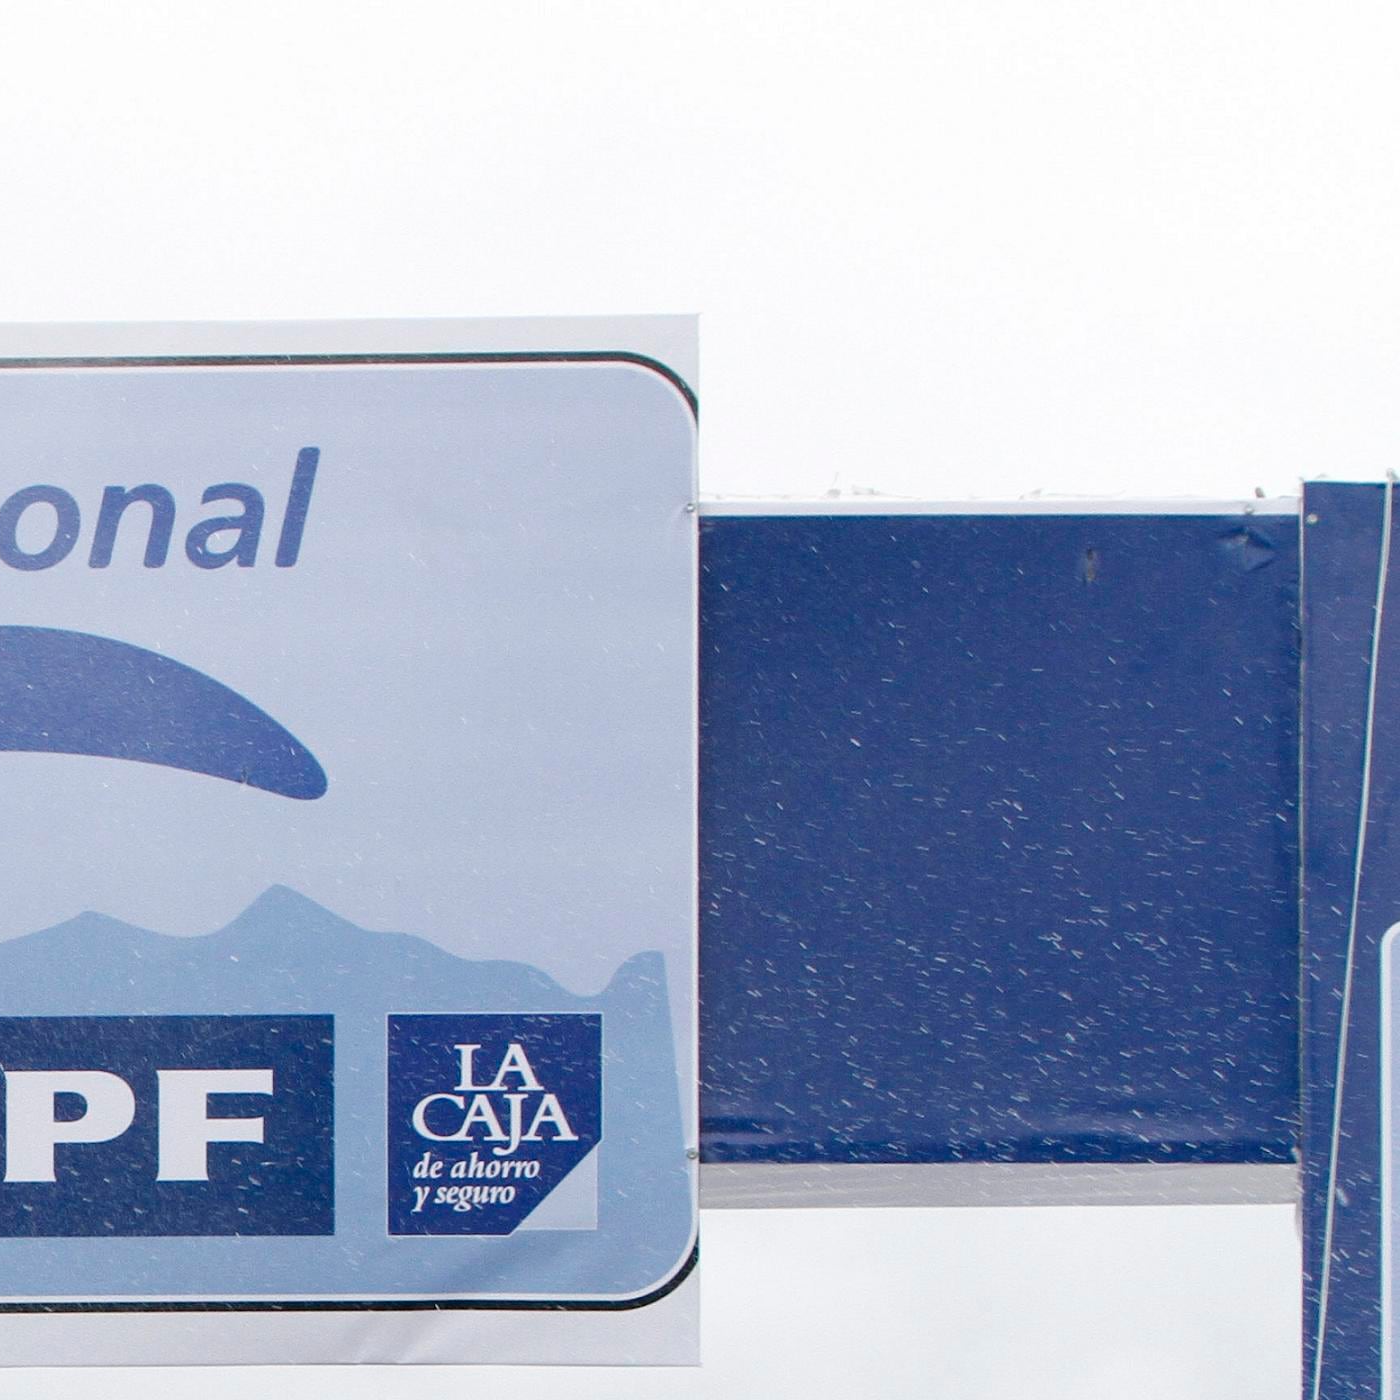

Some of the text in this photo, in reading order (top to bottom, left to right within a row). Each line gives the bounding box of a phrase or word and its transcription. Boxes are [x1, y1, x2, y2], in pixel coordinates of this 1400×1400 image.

[454, 1043, 544, 1091] LA
[412, 1093, 579, 1156] CAJA
[412, 1152, 540, 1178] de ahorro
[411, 1184, 516, 1213] y seguro
